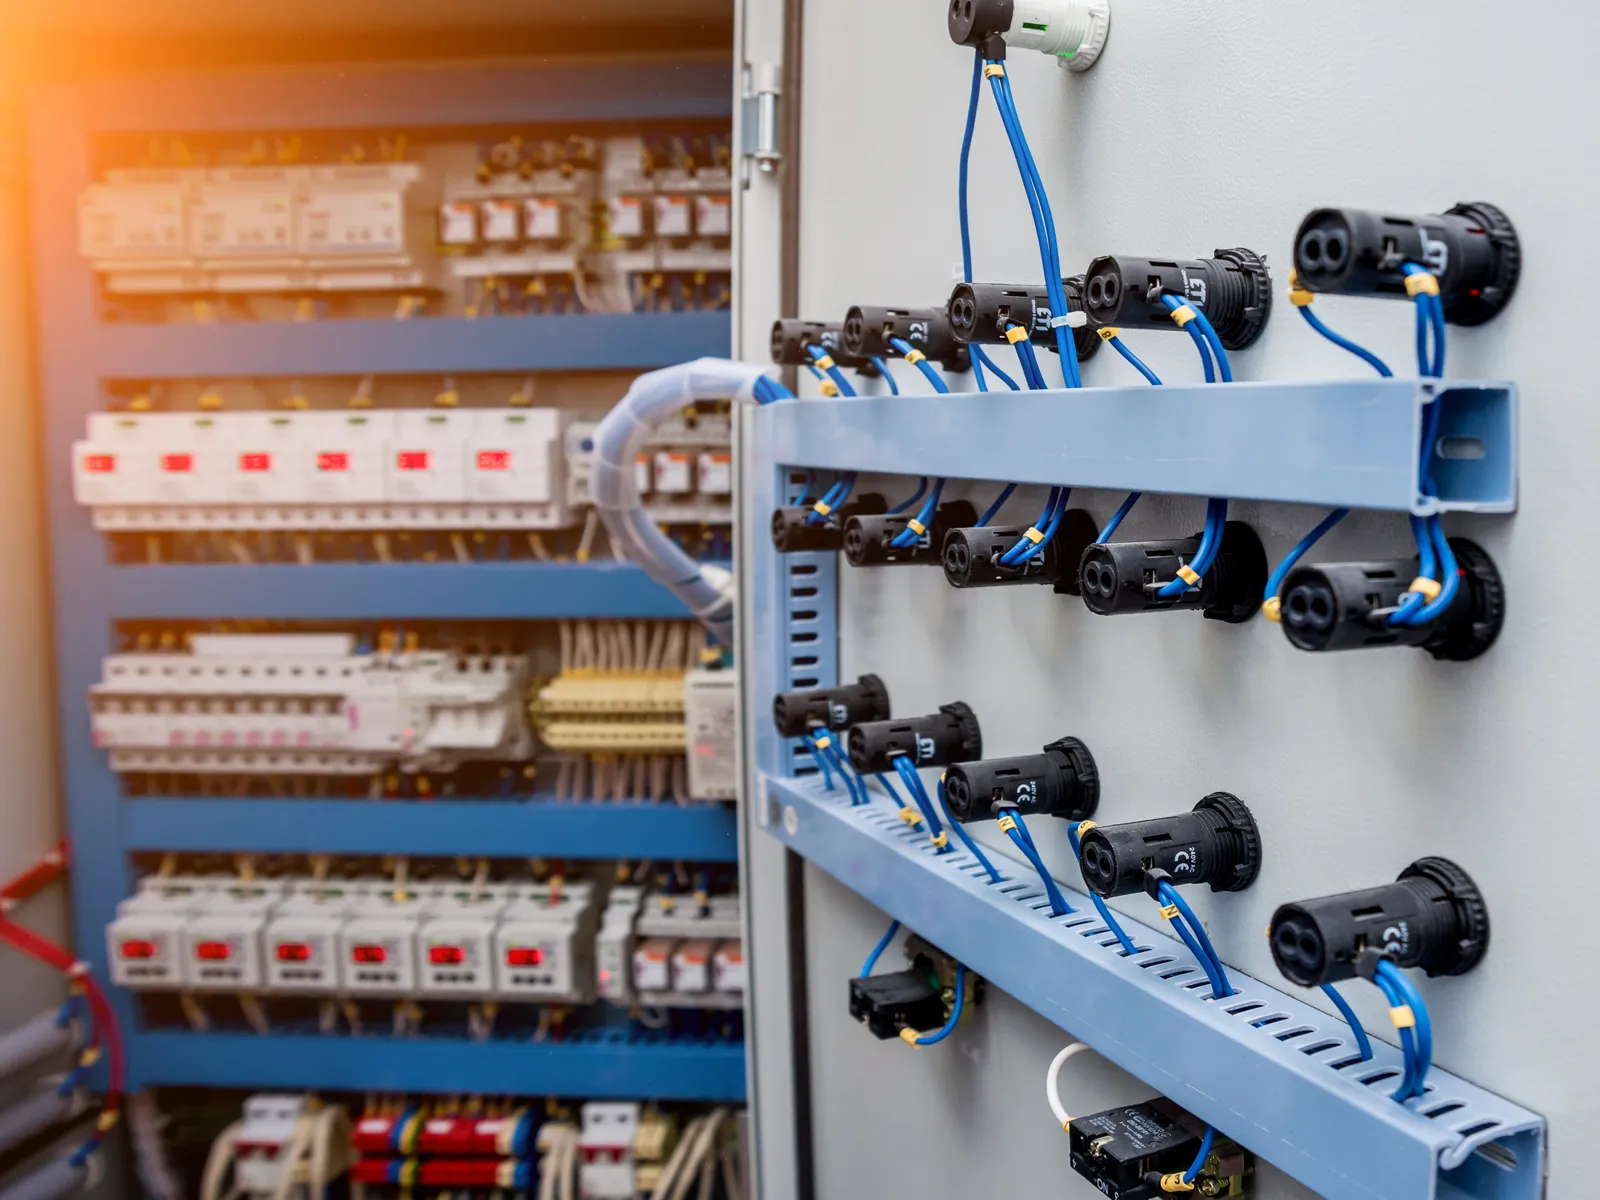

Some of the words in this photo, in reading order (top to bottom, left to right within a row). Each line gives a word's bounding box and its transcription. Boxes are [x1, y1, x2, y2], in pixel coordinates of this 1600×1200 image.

[1188, 278, 1207, 307] ETI
[1035, 307, 1052, 331] ETI
[919, 737, 936, 759] ETI
[1016, 784, 1031, 803] CE
[1174, 851, 1190, 873] CE
[1189, 846, 1197, 864] 240V
[1189, 864, 1197, 874] AC
